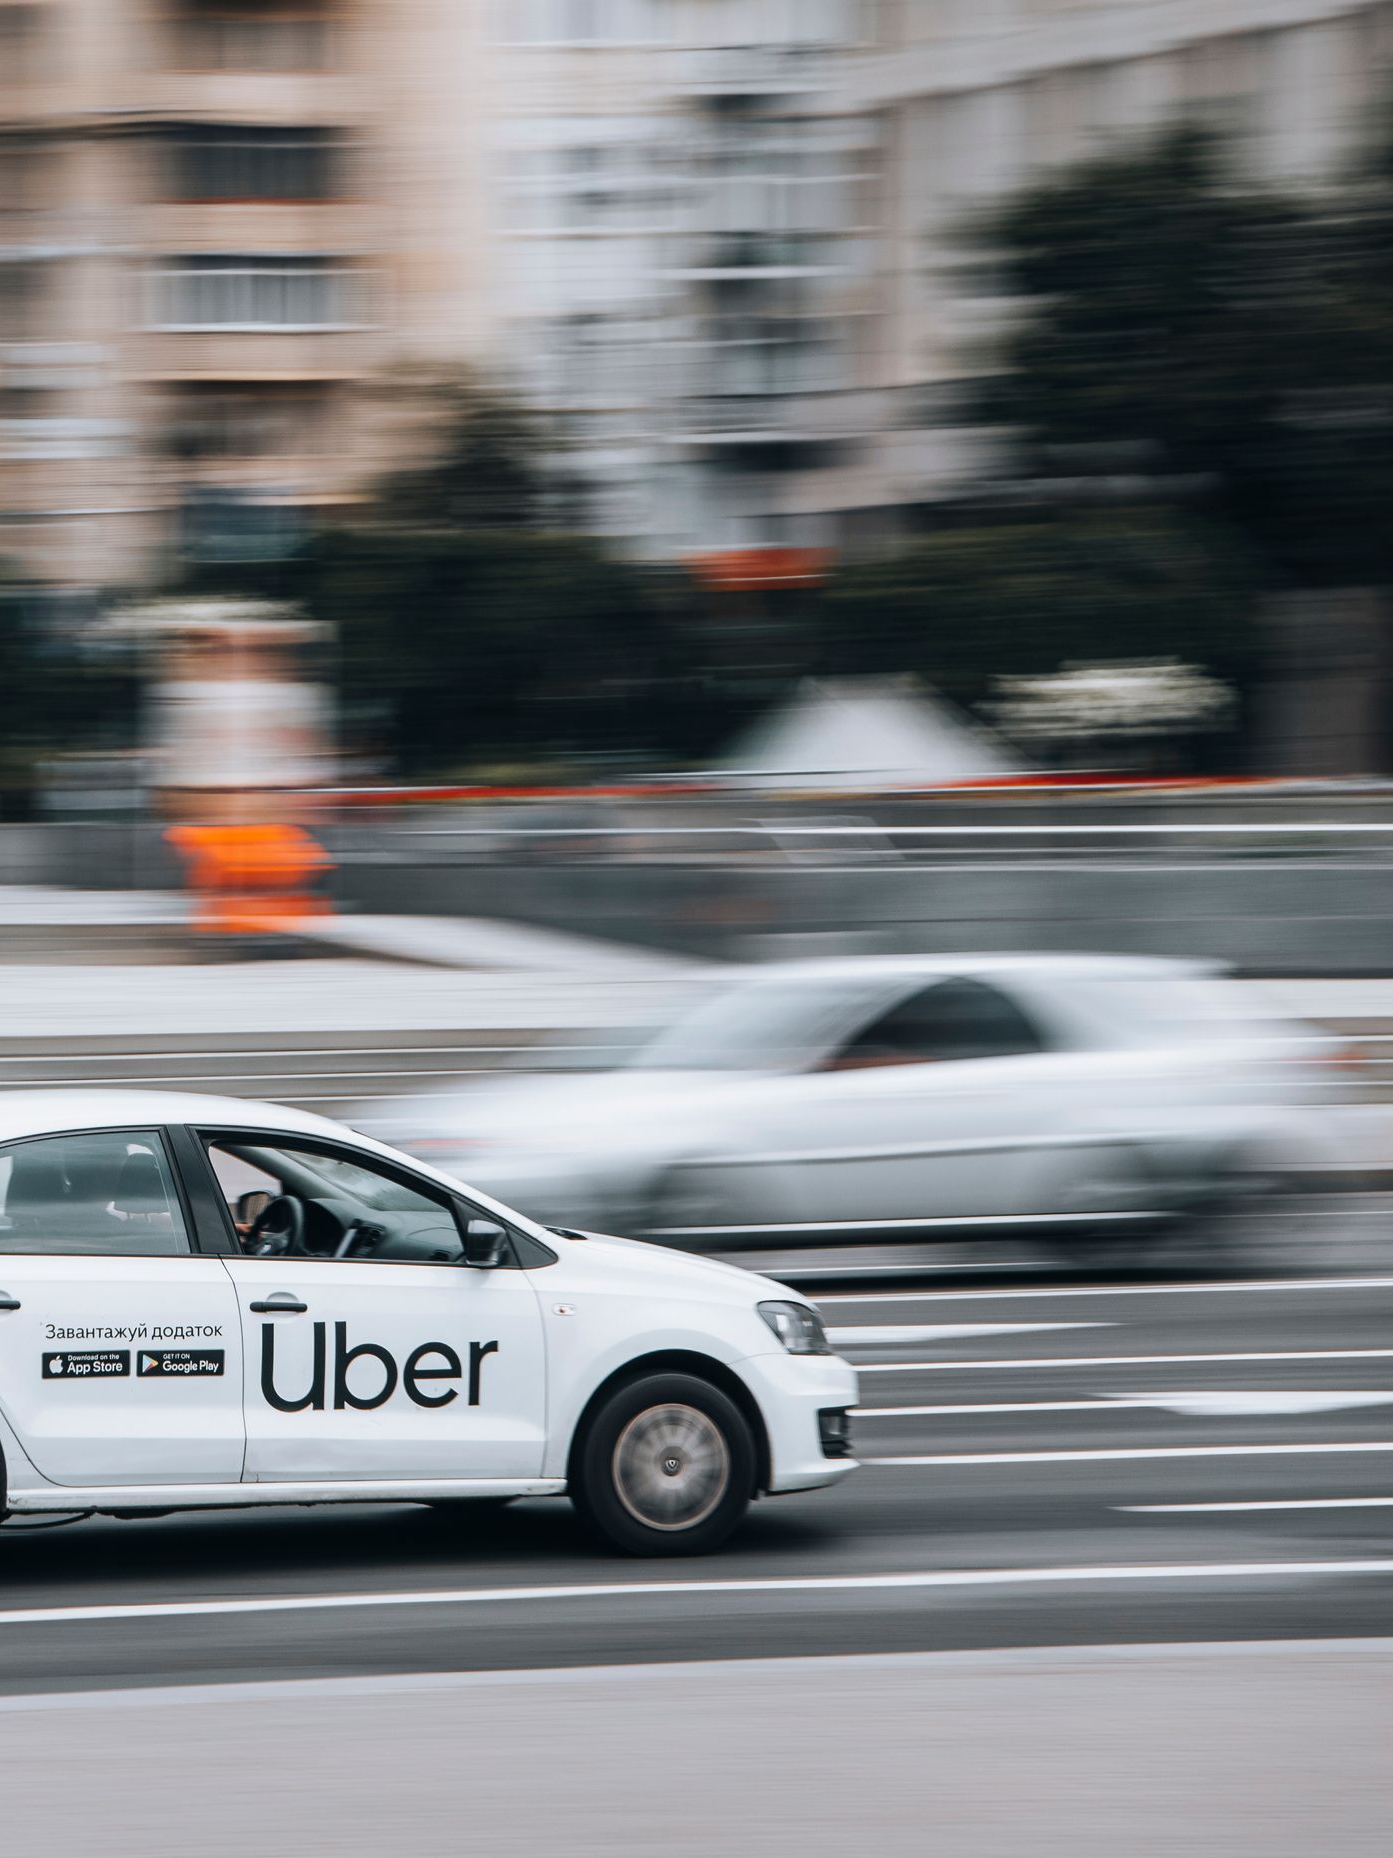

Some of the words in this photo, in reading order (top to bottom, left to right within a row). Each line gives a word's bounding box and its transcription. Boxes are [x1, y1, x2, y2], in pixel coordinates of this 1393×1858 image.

[45, 1323, 147, 1342] Завантажуй
[151, 1324, 223, 1340] додаток
[67, 1361, 91, 1375] App
[93, 1361, 123, 1373] Store
[162, 1361, 198, 1374] Google
[199, 1360, 219, 1374] Play
[260, 1321, 499, 1413] Uber
